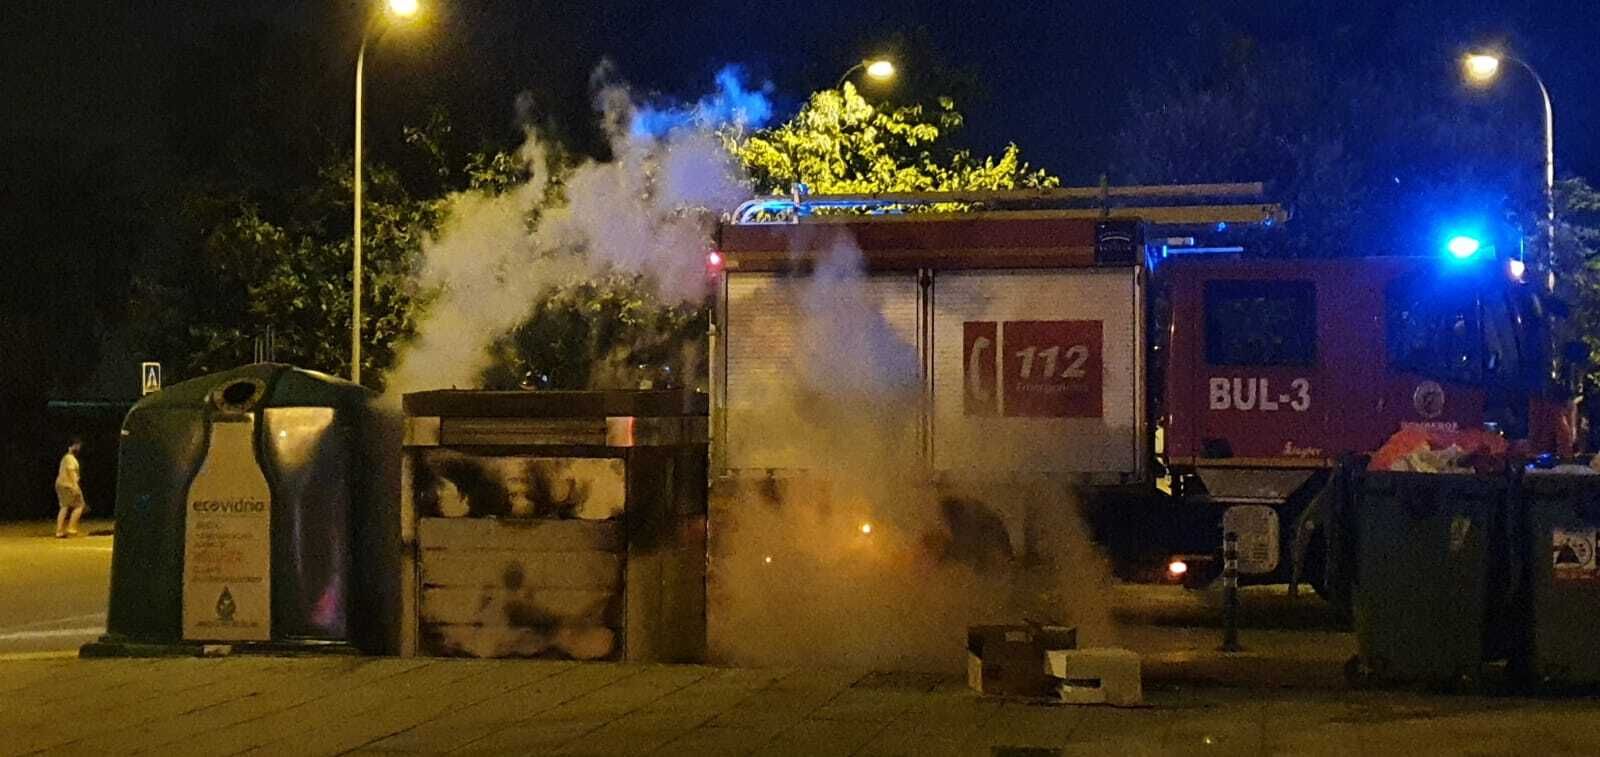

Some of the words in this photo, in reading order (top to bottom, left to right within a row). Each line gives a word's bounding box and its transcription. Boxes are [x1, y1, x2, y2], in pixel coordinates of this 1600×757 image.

[1016, 345, 1089, 378] 112
[1209, 377, 1311, 411] BUL-3
[193, 496, 265, 513] ecovidrio
